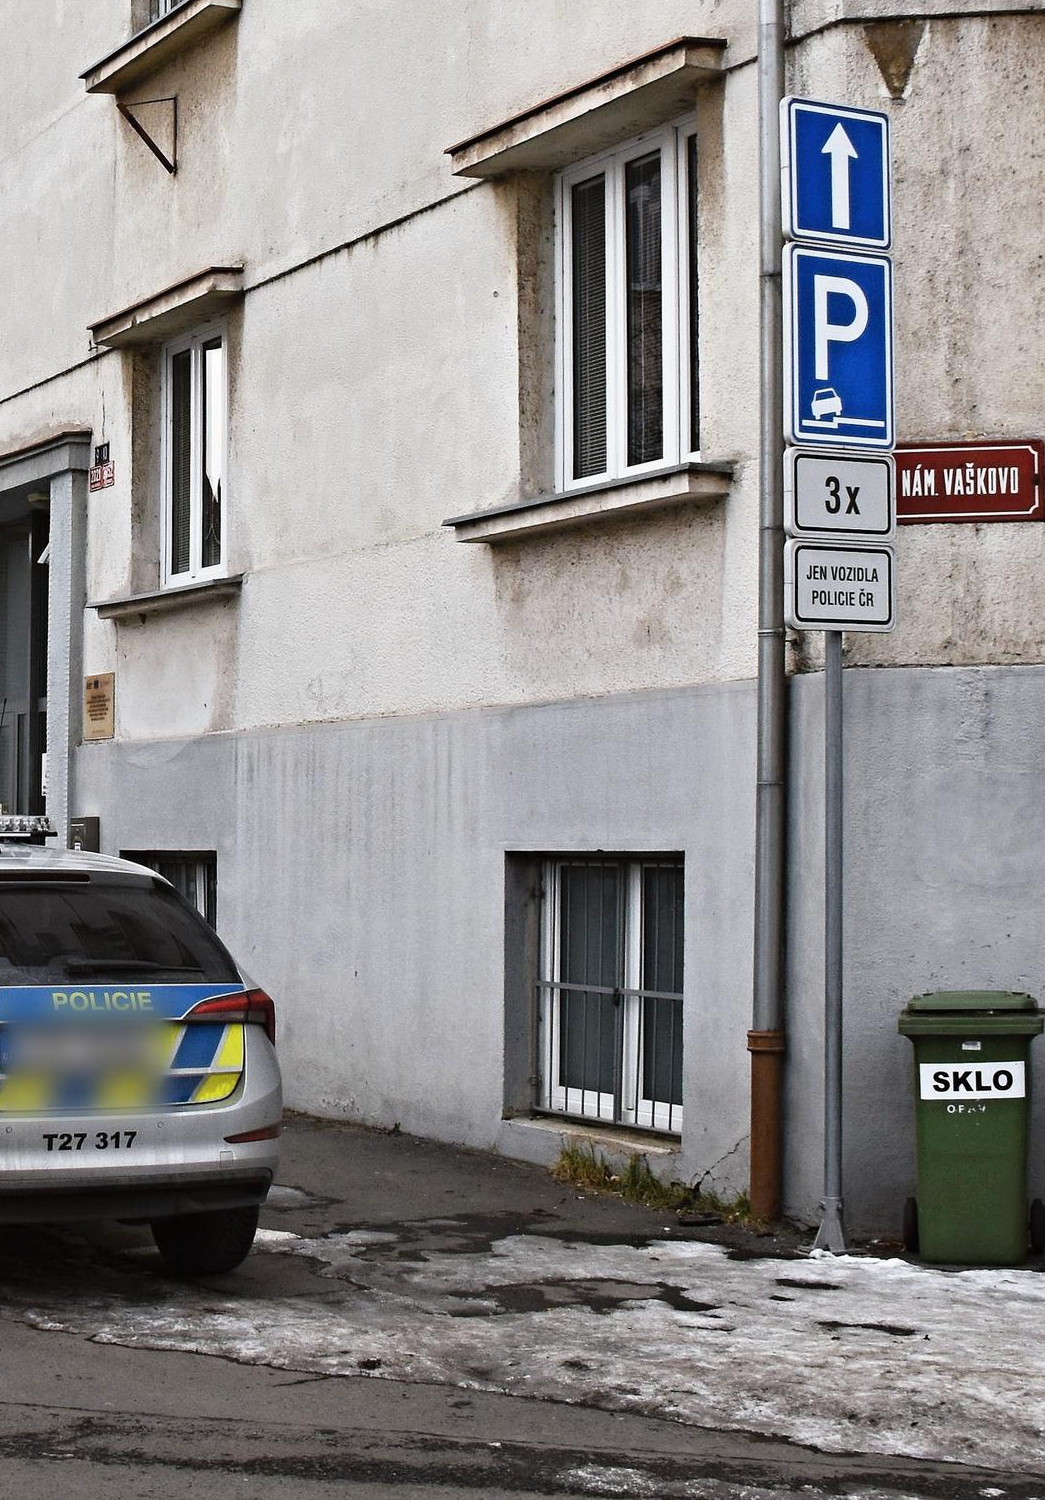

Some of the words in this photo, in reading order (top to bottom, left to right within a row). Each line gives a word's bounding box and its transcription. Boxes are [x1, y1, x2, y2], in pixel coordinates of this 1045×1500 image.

[813, 274, 869, 381] P
[901, 463, 940, 497] NÁM.
[943, 462, 1019, 496] VAŠKOVO
[824, 475, 861, 515] 3x
[806, 565, 827, 581] JEN
[831, 566, 879, 583] VOZIDLA
[812, 590, 856, 606] POLICIE
[858, 588, 874, 607] ČR
[51, 991, 154, 1012] POLICIE
[932, 1069, 1014, 1093] SKLO
[43, 1132, 88, 1151] T27
[95, 1131, 138, 1150] 317
